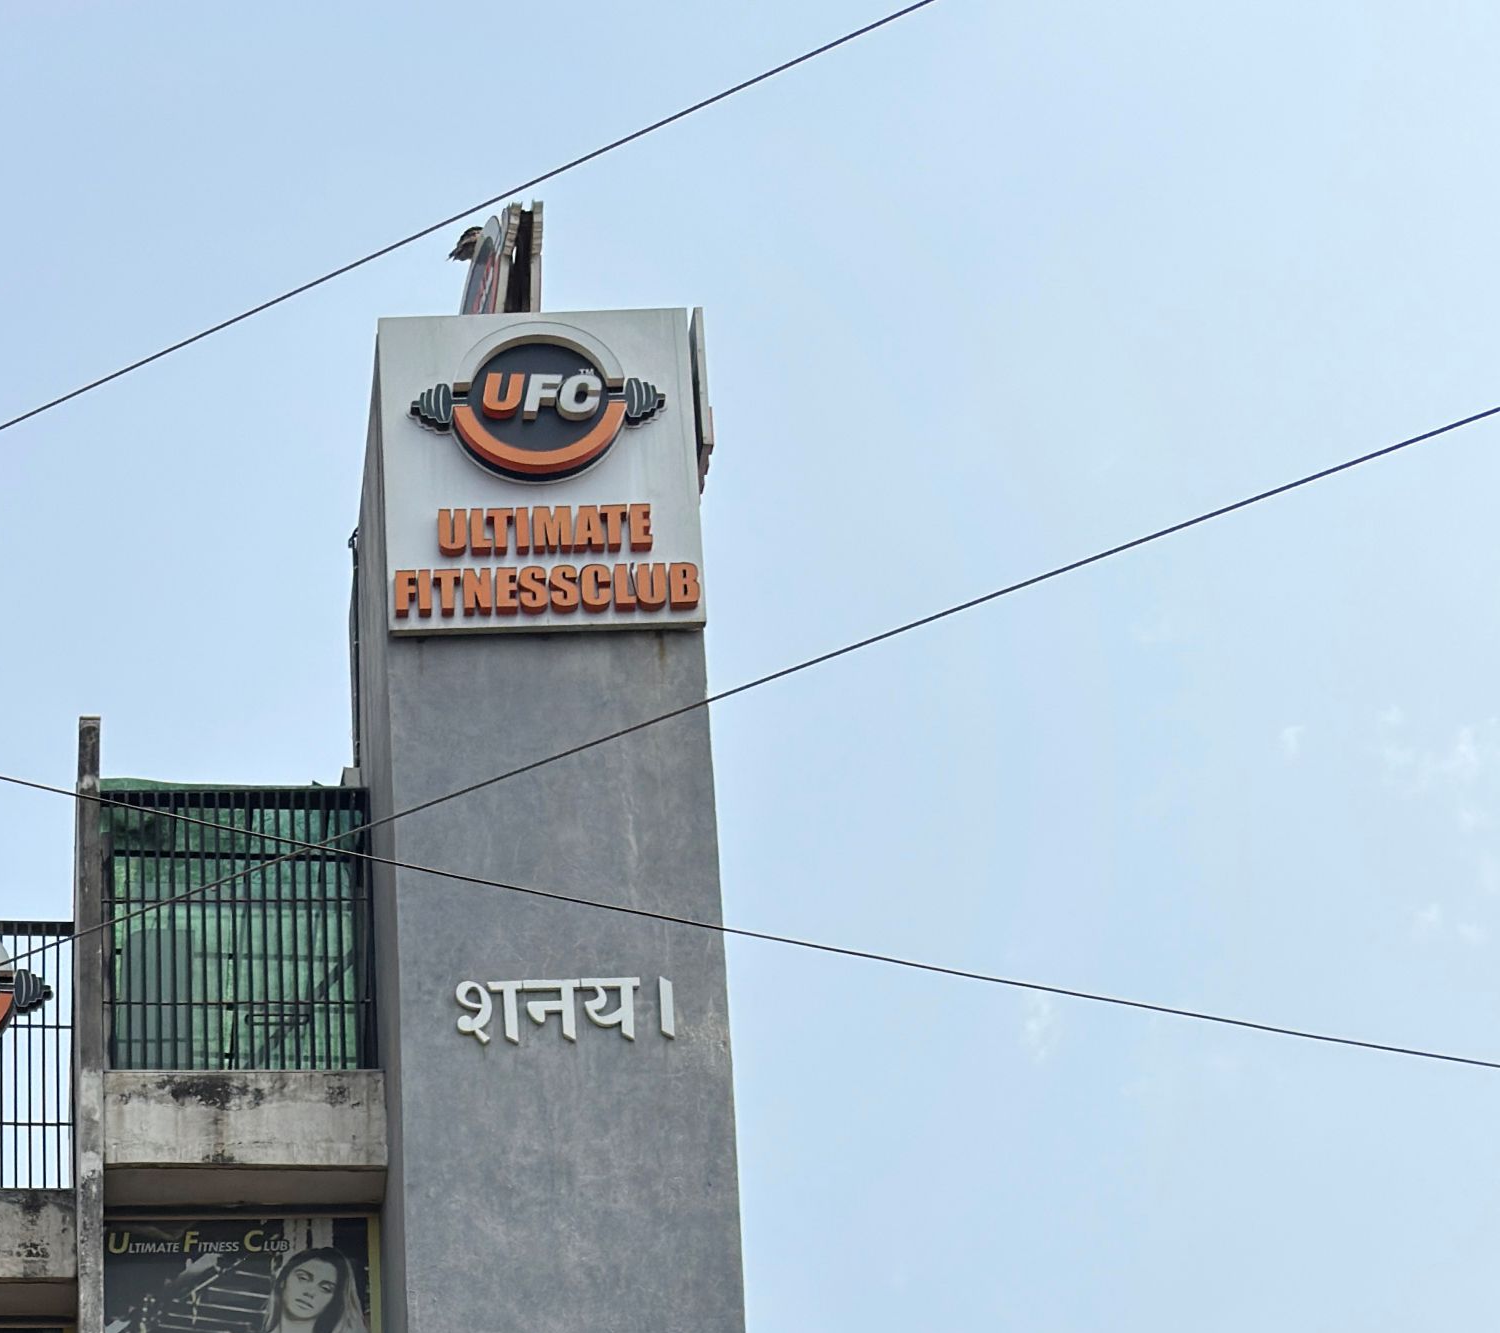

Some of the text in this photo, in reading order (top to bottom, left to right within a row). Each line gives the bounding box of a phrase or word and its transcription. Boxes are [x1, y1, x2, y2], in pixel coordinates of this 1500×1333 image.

[482, 372, 602, 422] UFC
[437, 503, 653, 557] ULTIMATE
[395, 562, 700, 618] FITNESSCLUB
